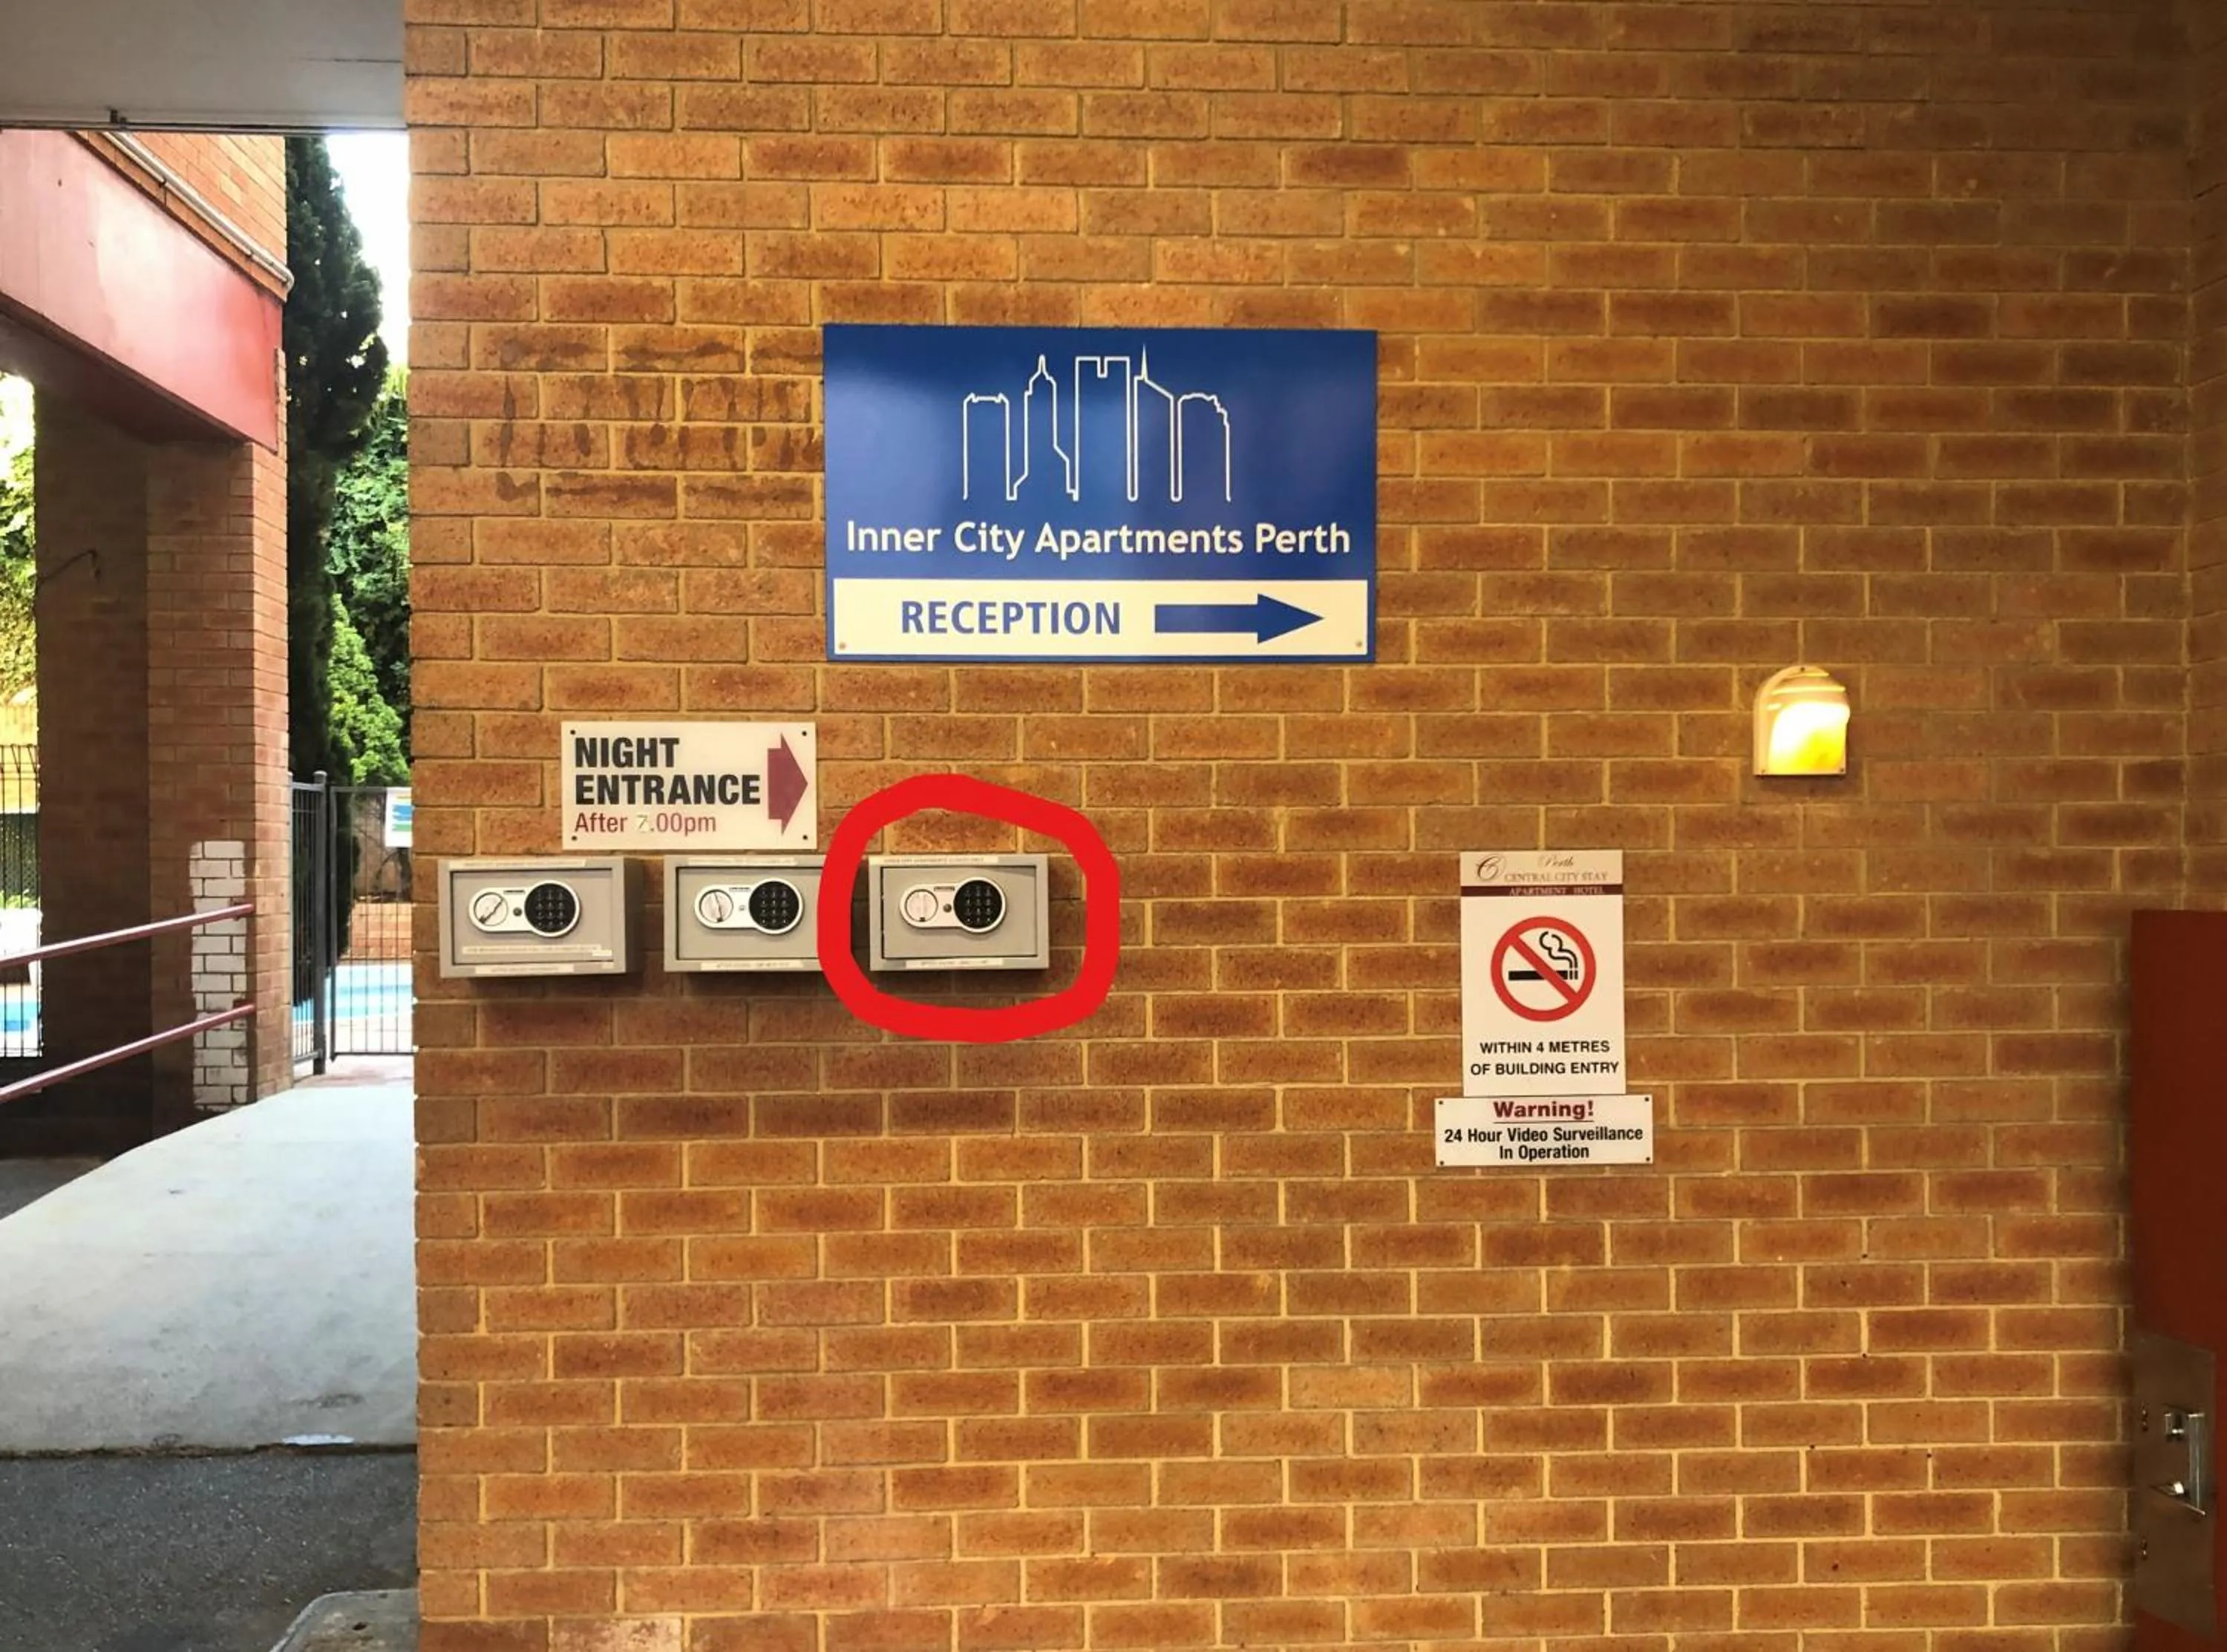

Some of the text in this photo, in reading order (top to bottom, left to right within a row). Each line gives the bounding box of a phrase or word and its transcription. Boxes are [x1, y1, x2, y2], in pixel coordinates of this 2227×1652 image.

[846, 521, 1350, 560] Inner City Apartments Perth
[901, 600, 1121, 635] RECEPTION
[575, 737, 680, 768] NIGHT
[575, 774, 761, 805] ENTRANCE
[575, 813, 628, 832] After
[1504, 871, 1609, 882] CENTRAL CITY STAY
[1508, 886, 1605, 897] APARTMENT HOTEL
[1479, 1040, 1610, 1054] WITHIN 4 METRES
[1471, 1061, 1619, 1075] OF BUILDING ENTRY
[1493, 1101, 1595, 1120] Warning!
[1444, 1126, 1644, 1143] 24 Hour Video Surveillance
[1499, 1144, 1589, 1162] In Operation
